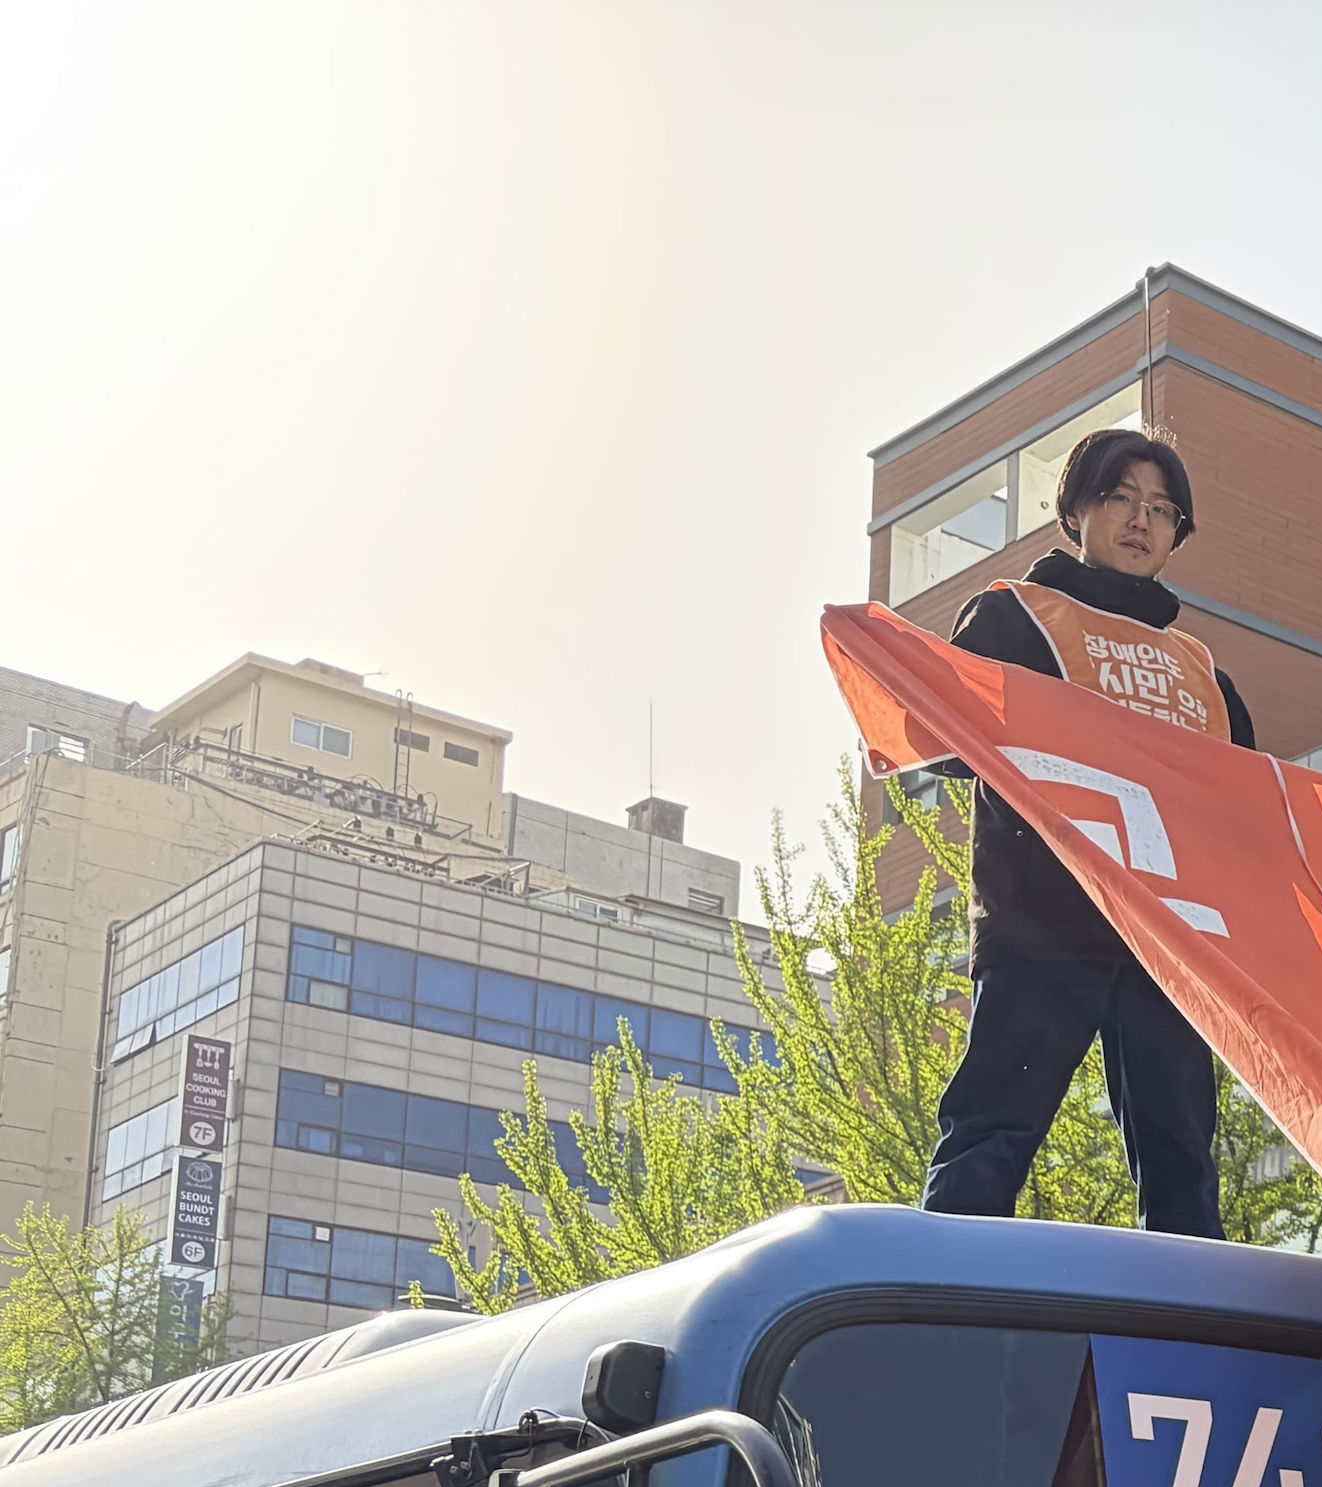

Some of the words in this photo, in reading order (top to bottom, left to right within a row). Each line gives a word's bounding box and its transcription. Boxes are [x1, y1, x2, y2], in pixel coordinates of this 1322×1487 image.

[1083, 633, 1185, 681] 장애인도
[192, 1073, 222, 1087] SEOUL
[185, 1082, 227, 1098] COOKING
[193, 1095, 217, 1108] CLUB
[193, 1126, 212, 1141] 7F
[180, 1190, 214, 1205] SEOUL
[178, 1202, 215, 1216] BUNDT
[178, 1213, 211, 1227] CAKES
[183, 1245, 204, 1258] 6F
